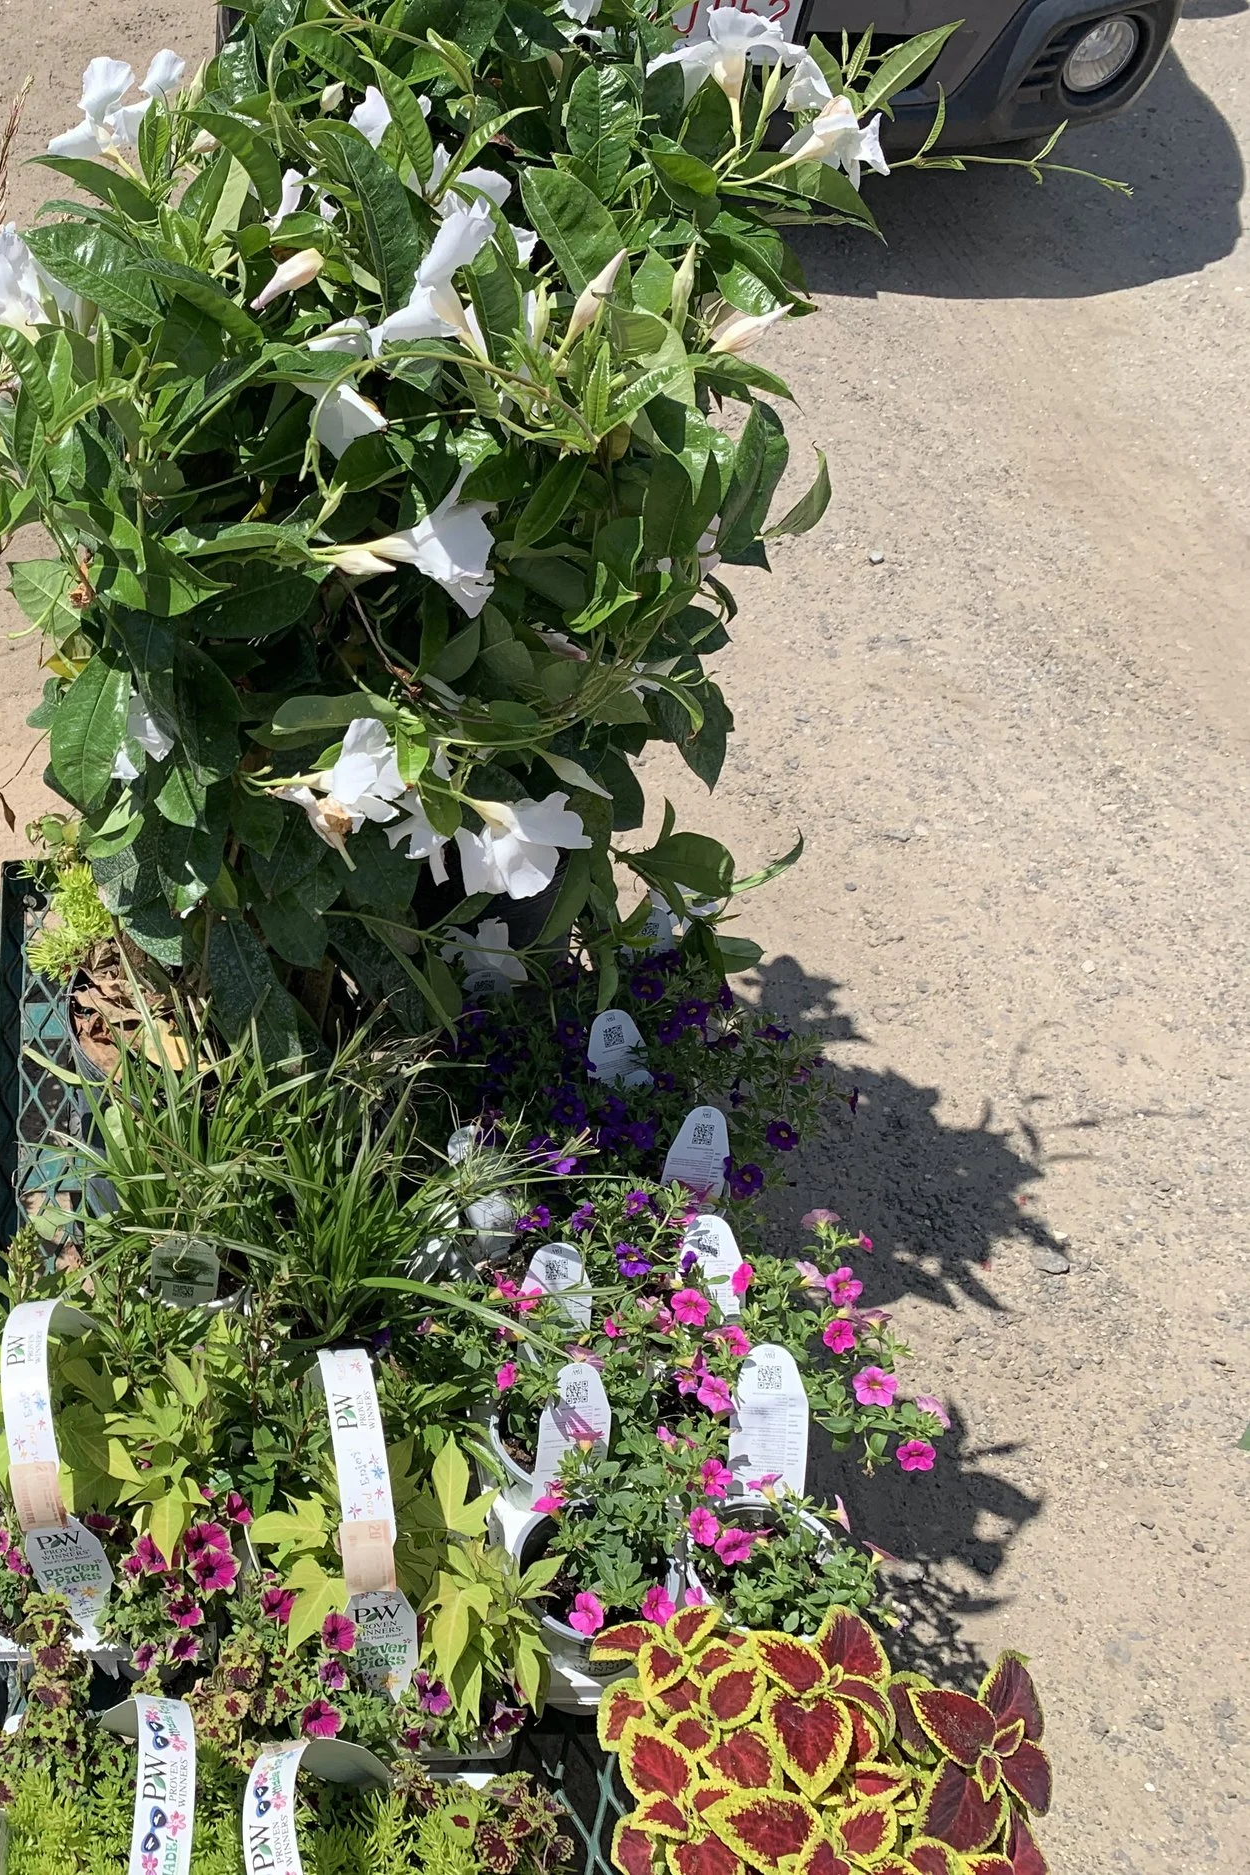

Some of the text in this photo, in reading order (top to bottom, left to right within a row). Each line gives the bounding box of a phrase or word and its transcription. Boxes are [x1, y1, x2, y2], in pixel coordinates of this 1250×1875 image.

[6, 1335, 26, 1366] PW
[332, 1393, 358, 1431] PW
[356, 1394, 367, 1426] PROVEN
[365, 1389, 376, 1429] WINNERS
[35, 1530, 81, 1550] PW
[41, 1550, 89, 1561] WINNERS
[43, 1545, 83, 1556] PROVEN
[353, 1604, 402, 1623] PW
[142, 1753, 168, 1804] PW
[169, 1760, 178, 1801] PROVEN
[178, 1758, 188, 1807] WINNERS
[249, 1824, 276, 1872] PW
[273, 1821, 283, 1864] PROVEN
[281, 1814, 293, 1867] WINNERS
